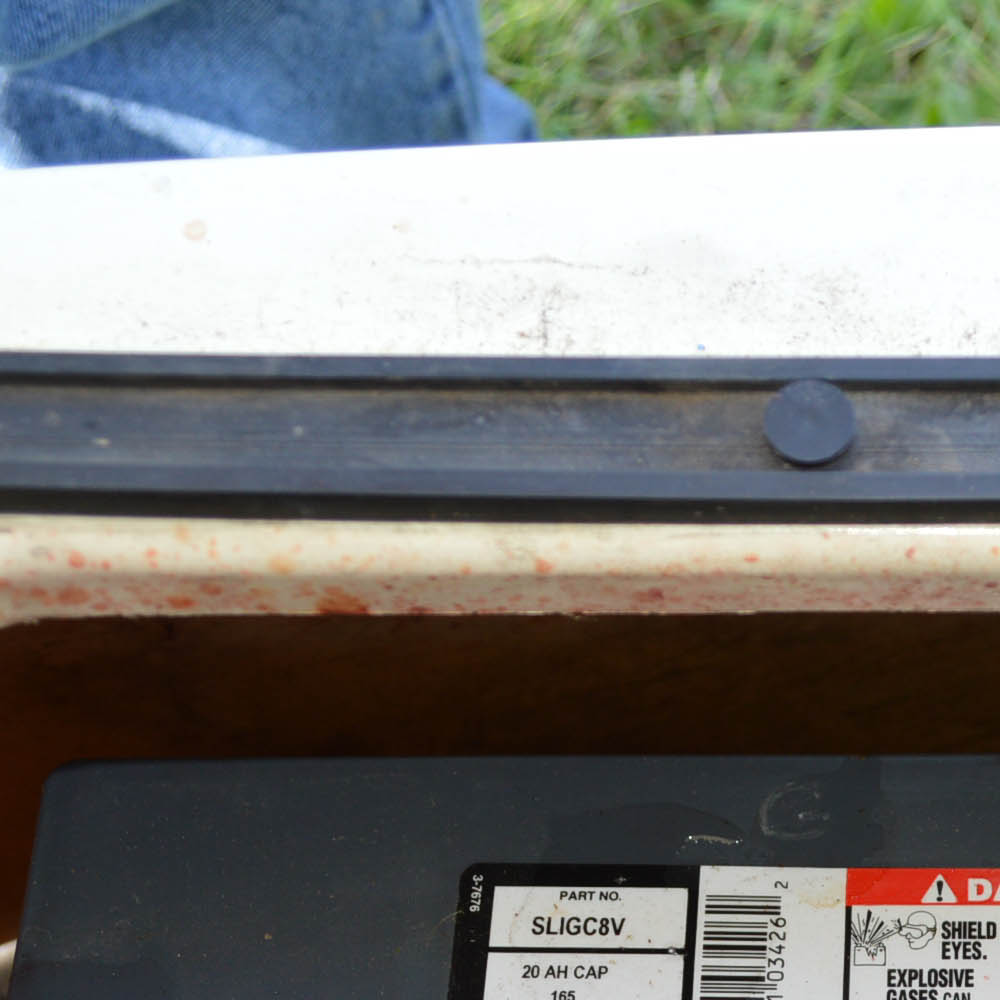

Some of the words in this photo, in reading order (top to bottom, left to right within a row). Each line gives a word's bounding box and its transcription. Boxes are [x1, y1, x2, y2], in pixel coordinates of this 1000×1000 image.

[469, 873, 484, 913] 3-7676
[775, 880, 789, 890] 2
[559, 890, 596, 902] PART
[599, 890, 622, 903] NO.
[531, 916, 626, 937] SLIGC8V
[941, 921, 997, 940] SHIELD
[767, 917, 786, 982] 03426
[941, 941, 988, 960] EYES.
[521, 965, 541, 980] 20
[544, 965, 569, 980] AH
[573, 965, 609, 980] CAP
[886, 969, 975, 988] EXPLOSIVE
